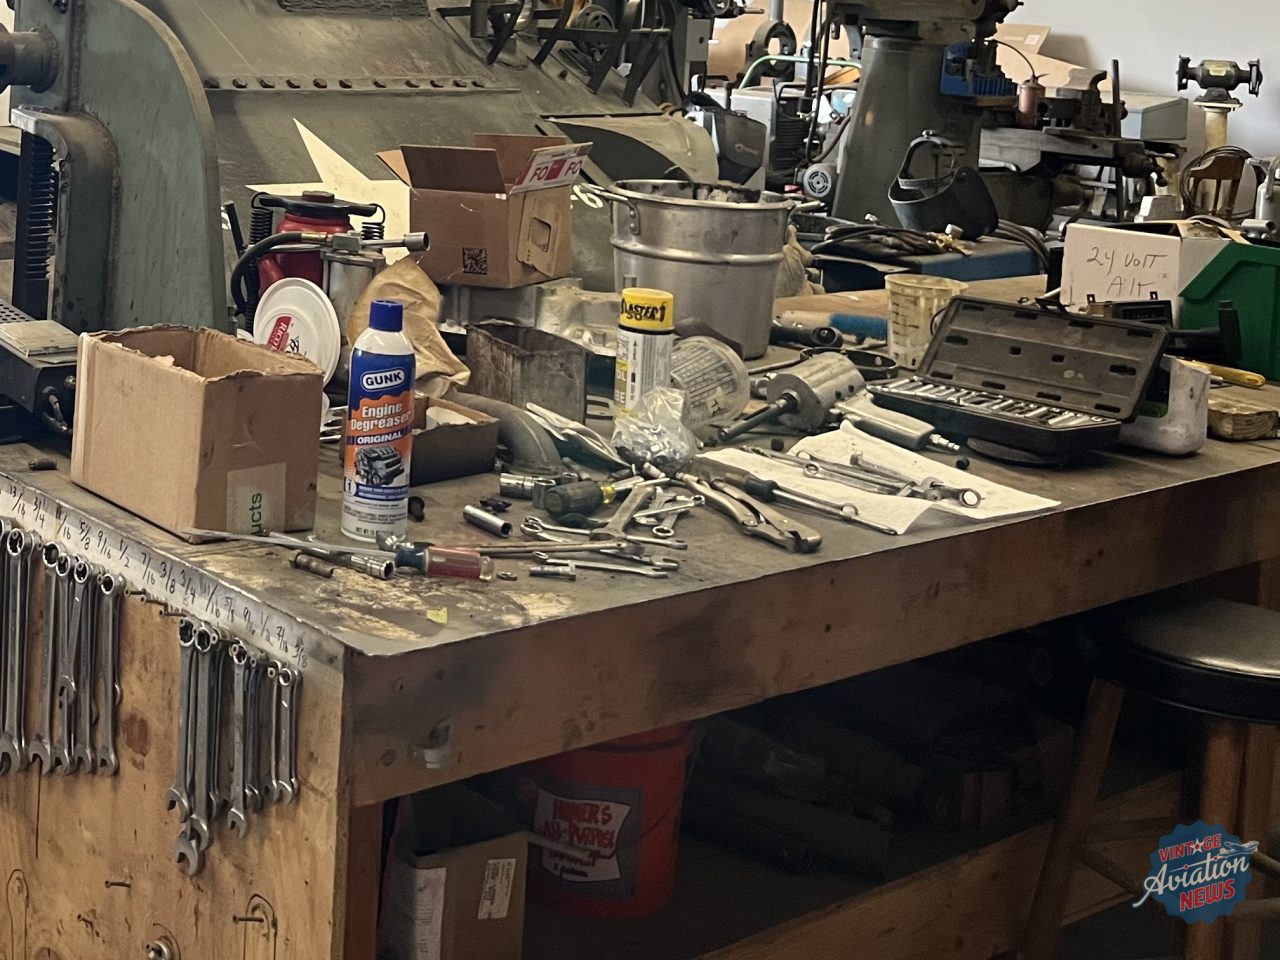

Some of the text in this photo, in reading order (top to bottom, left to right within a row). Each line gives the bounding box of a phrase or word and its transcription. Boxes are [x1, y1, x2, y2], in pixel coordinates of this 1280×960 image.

[365, 371, 402, 386] GUNK
[362, 403, 402, 418] Engine
[351, 411, 411, 432] Degreaser
[357, 431, 402, 444] ORIGINAL
[9, 486, 26, 516] 13/16
[97, 530, 111, 559] 9/16
[119, 538, 130, 568] 1/2
[141, 552, 155, 585] 7/16
[160, 561, 176, 594] 3/8
